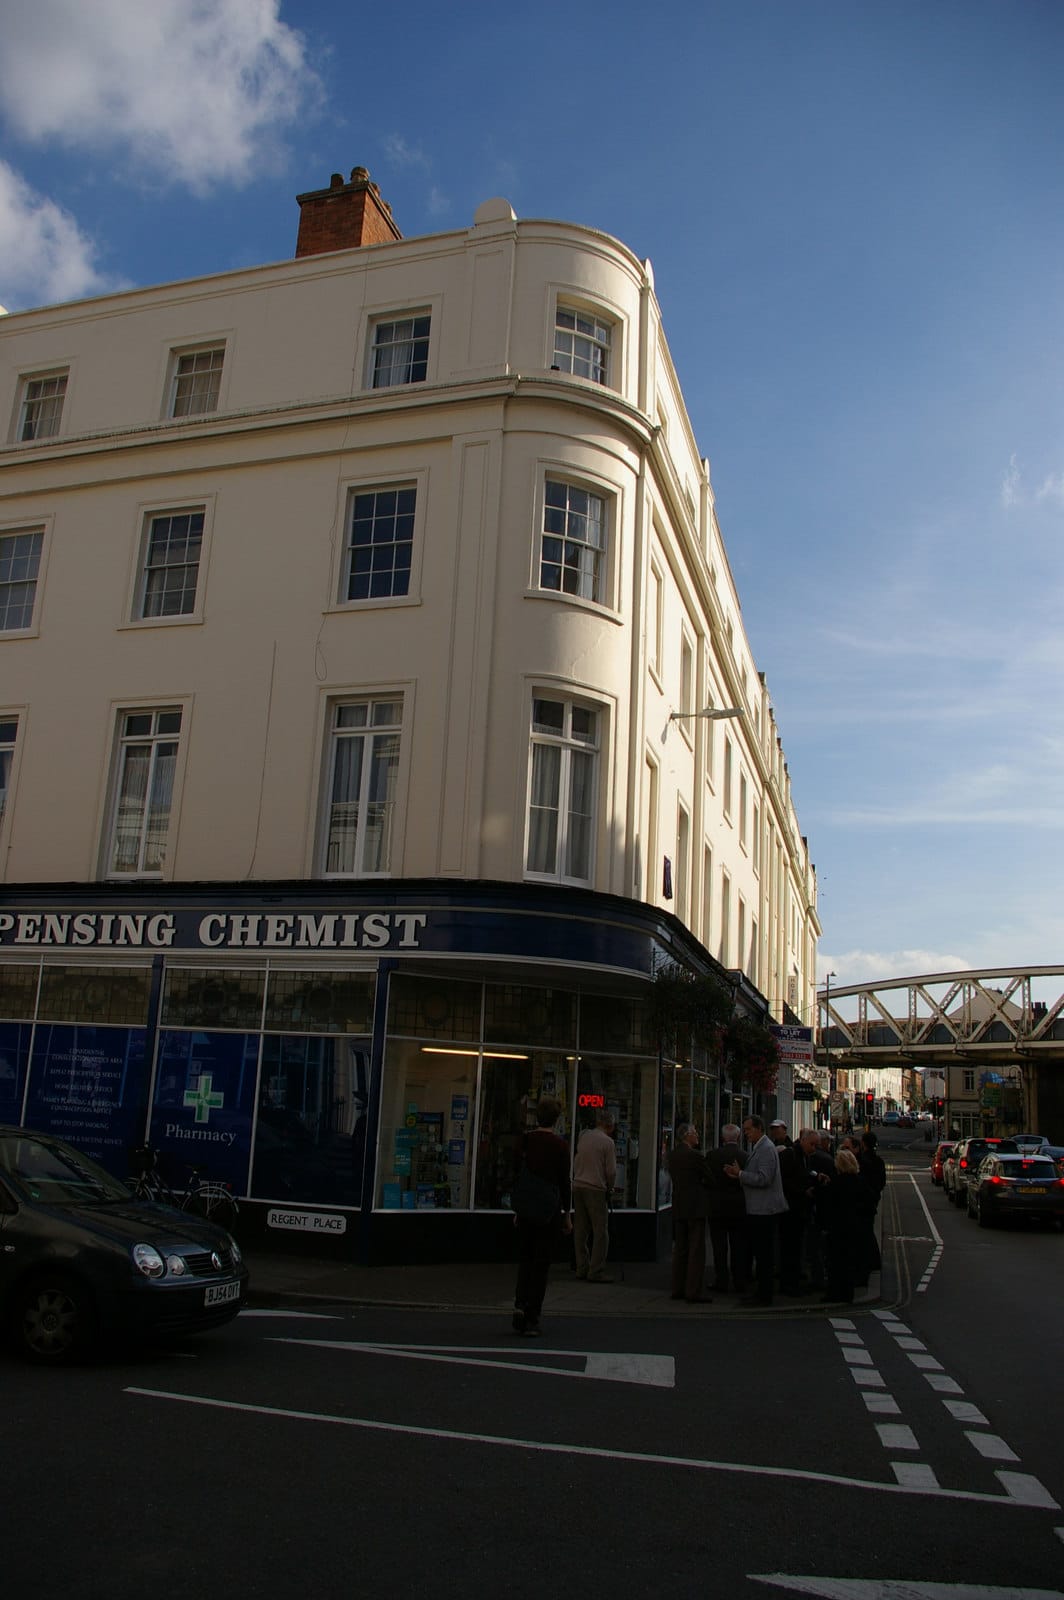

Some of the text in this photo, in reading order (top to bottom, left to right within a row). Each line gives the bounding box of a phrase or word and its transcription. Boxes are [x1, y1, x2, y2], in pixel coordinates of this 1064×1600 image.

[198, 913, 428, 947] CHEMIST
[578, 1093, 604, 1108] OPEN
[165, 1123, 237, 1147] Pharmacy
[271, 1213, 342, 1230] REGENT PLACE
